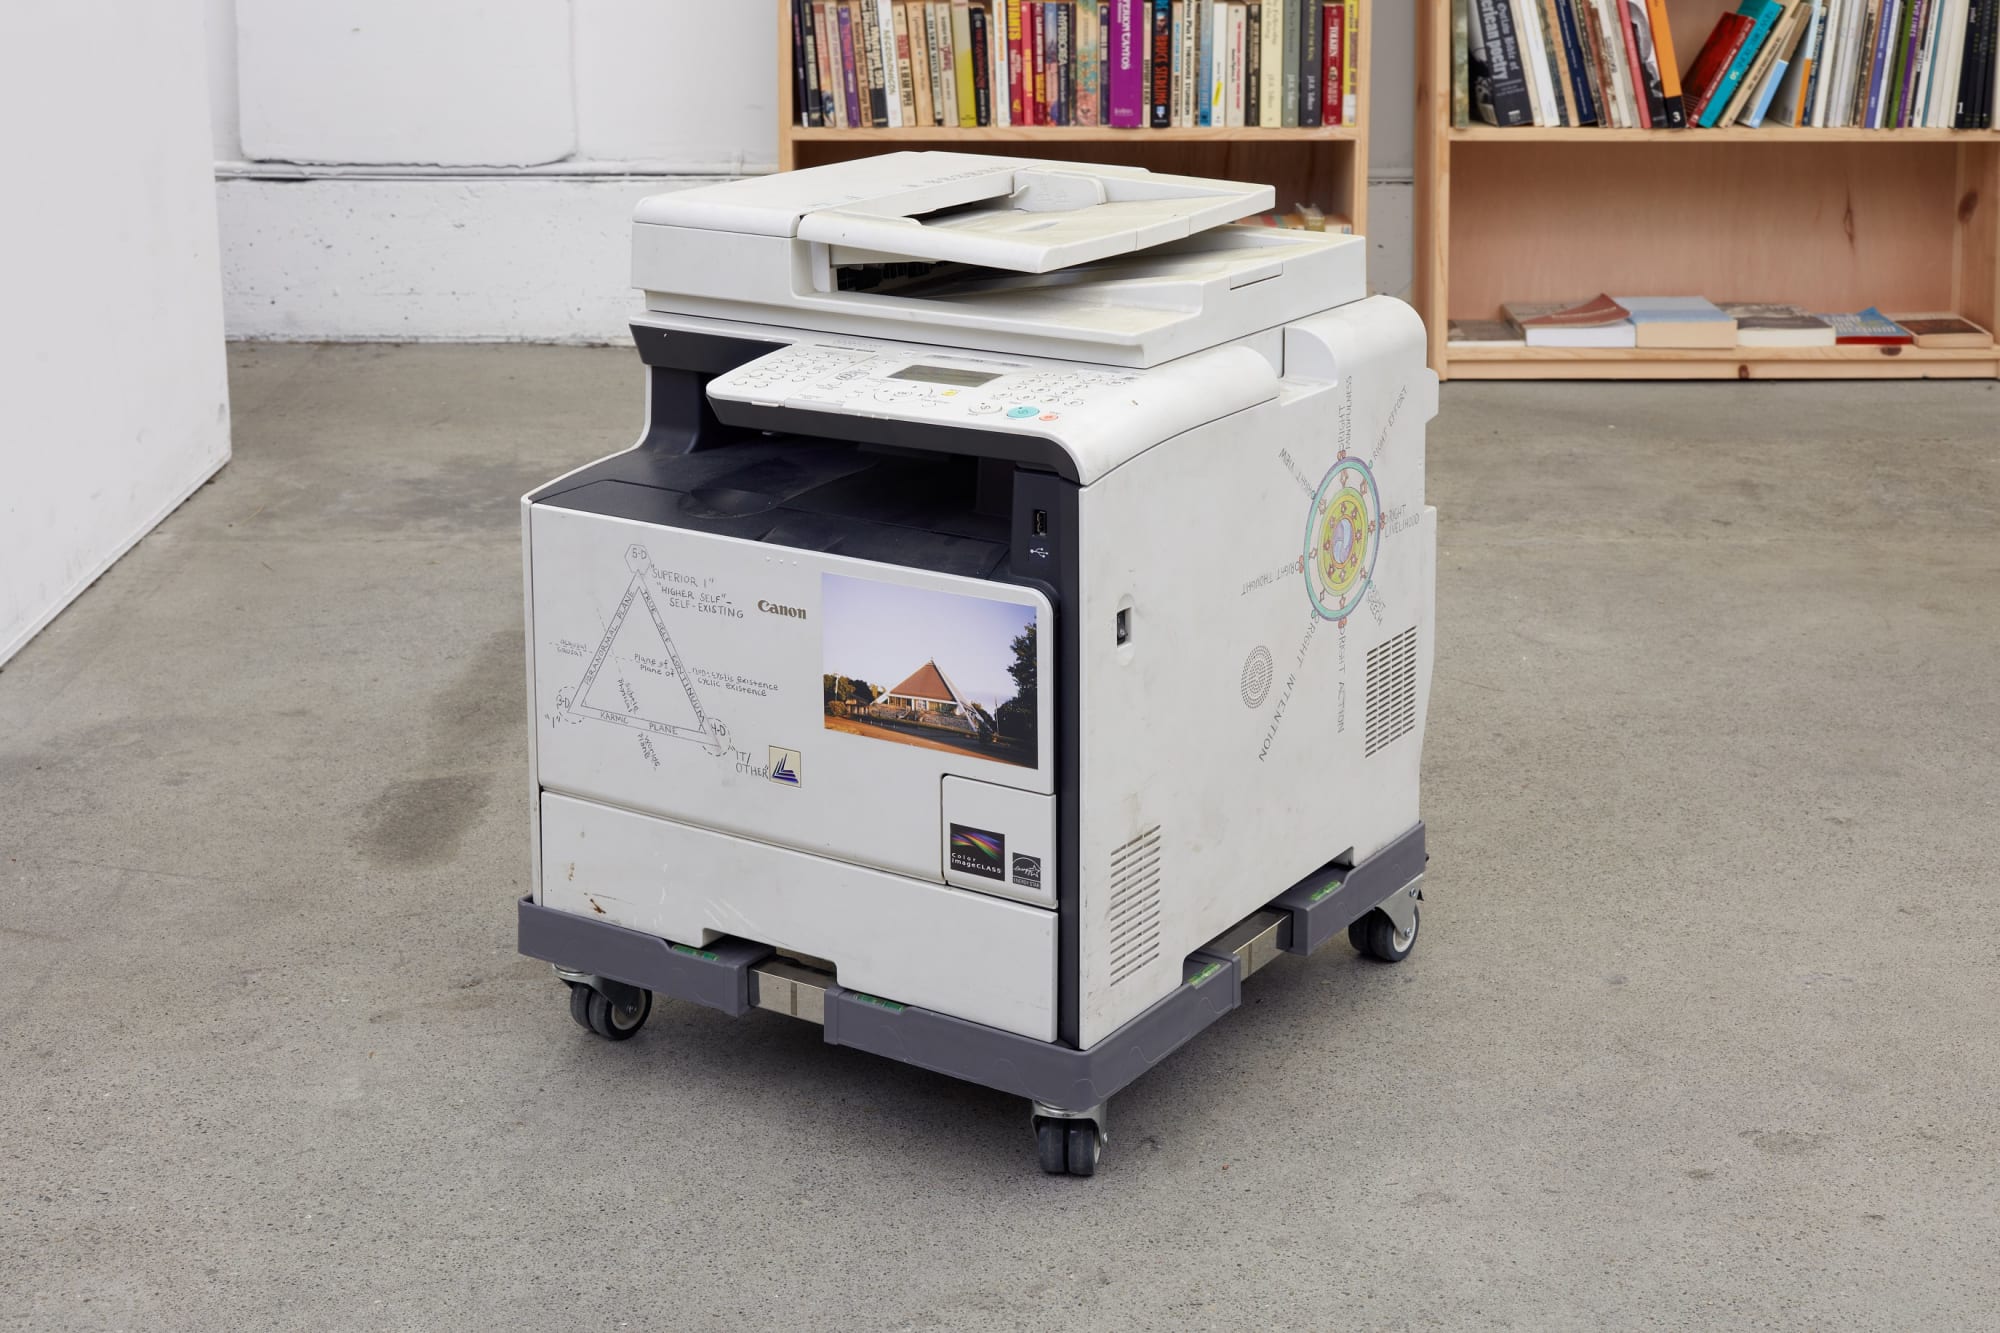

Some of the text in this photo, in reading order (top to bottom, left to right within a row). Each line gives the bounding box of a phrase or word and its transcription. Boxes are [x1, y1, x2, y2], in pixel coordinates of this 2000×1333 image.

[1058, 11, 1068, 65] HYPERBOREA
[1909, 17, 1918, 37] LINES
[884, 30, 896, 95] NECRONOMICON
[1120, 32, 1131, 70] CANTOS
[1486, 40, 1508, 80] poetry
[1154, 35, 1169, 105] BRUCE STERLING
[1673, 112, 1681, 122] 3
[1957, 102, 1964, 114] 1
[1384, 513, 1420, 538] LIVELIHOOD
[1389, 504, 1406, 524] RIGHT
[632, 547, 647, 559] 5-D
[1241, 564, 1295, 596] RIGHT THOUGHT
[758, 599, 807, 620] Canon
[585, 591, 634, 685] PARANORMAL PLANE
[643, 591, 705, 722] TRUE SELF CONTINUUM
[726, 683, 767, 697] existence
[1258, 622, 1316, 763] RIGHT INTENTION
[1337, 634, 1346, 734] RIGHT ACTION
[600, 711, 679, 735] KARMIC PLANE
[951, 852, 976, 862] Color
[951, 858, 1002, 874] imageCLASS
